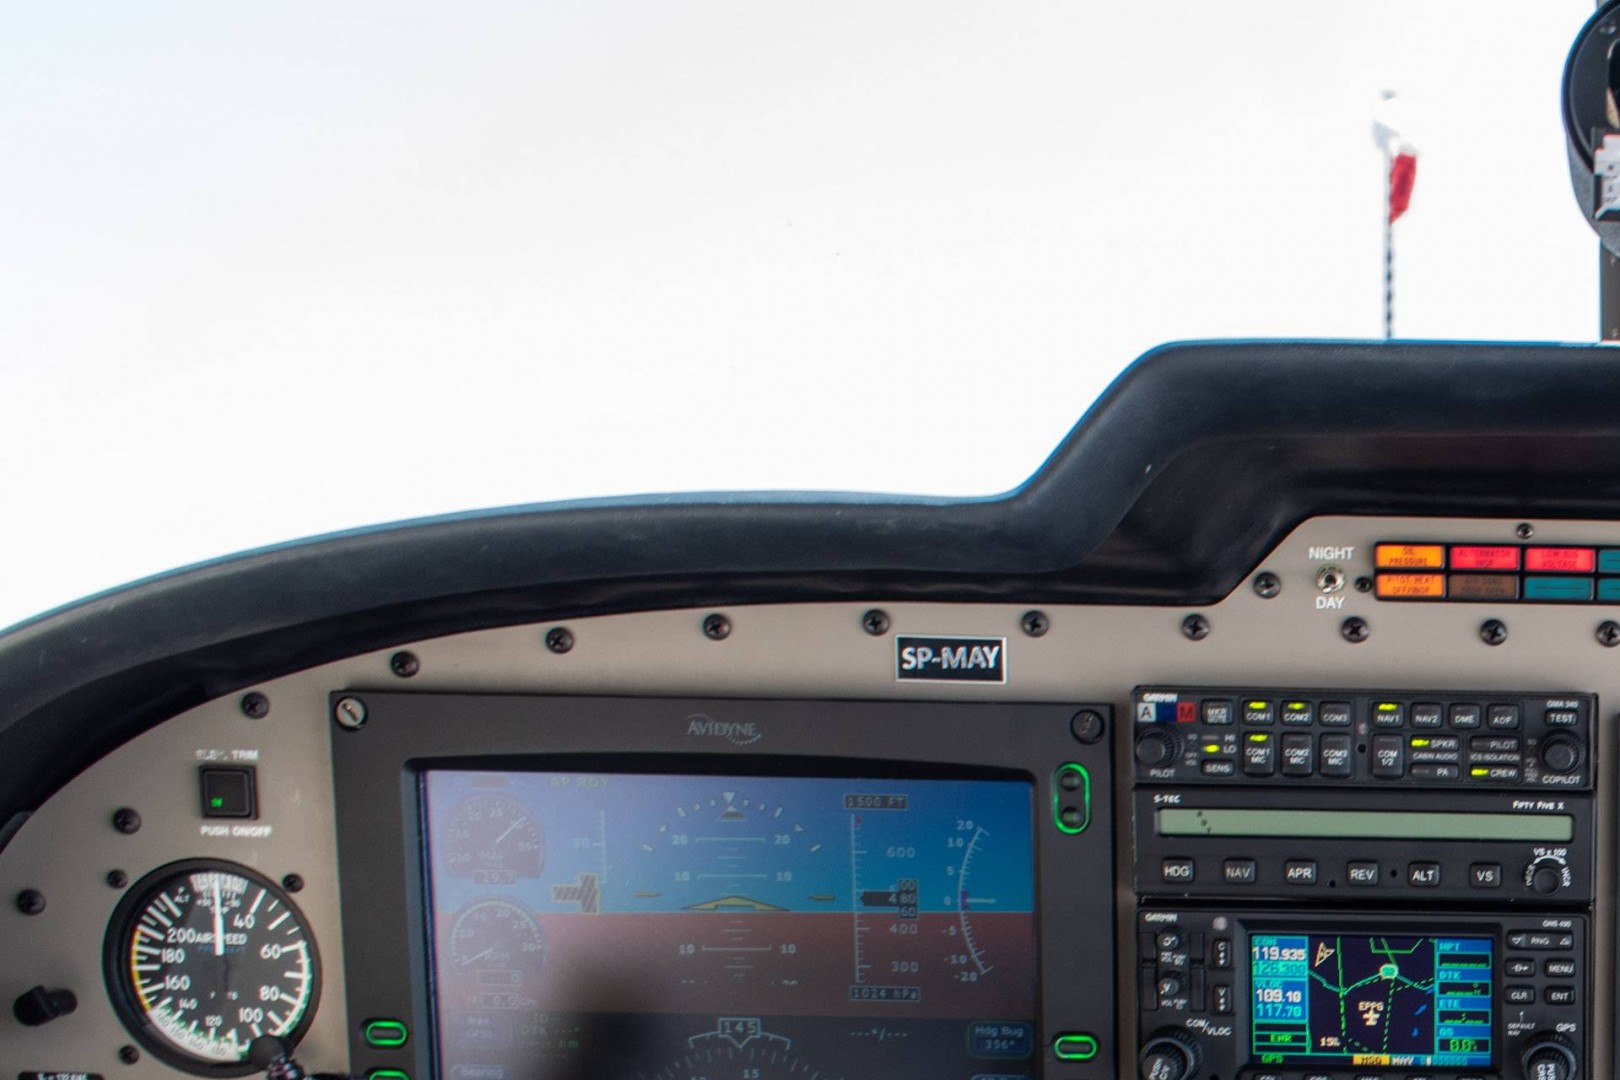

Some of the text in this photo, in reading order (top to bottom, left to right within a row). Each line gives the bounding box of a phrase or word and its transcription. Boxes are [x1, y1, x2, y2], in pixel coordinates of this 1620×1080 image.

[1308, 547, 1354, 560] NIGHT
[1316, 597, 1344, 610] DAY
[902, 646, 1000, 670] SP-MAY
[1246, 712, 1271, 721] COM1
[1284, 713, 1310, 722] COM2
[1415, 715, 1438, 723] NAV2
[1455, 715, 1474, 723] DME
[1549, 714, 1574, 722] TEST
[686, 721, 757, 736] AVIDYNE
[1150, 769, 1176, 777] PILOT
[1542, 776, 1581, 784] COPILOT
[1165, 866, 1190, 877] HDG
[1226, 867, 1250, 878] NAV
[1287, 868, 1312, 879] APR
[1351, 869, 1375, 880] REV
[1412, 870, 1435, 881] ALT
[1476, 870, 1494, 881] VS
[233, 915, 255, 928] 40
[168, 929, 195, 943] 200
[261, 946, 282, 959] 60
[1549, 964, 1573, 973] MENU
[260, 987, 281, 1000] 80
[1511, 992, 1527, 1000] CLR
[1551, 992, 1569, 1000] ENT
[239, 1008, 263, 1023] 100
